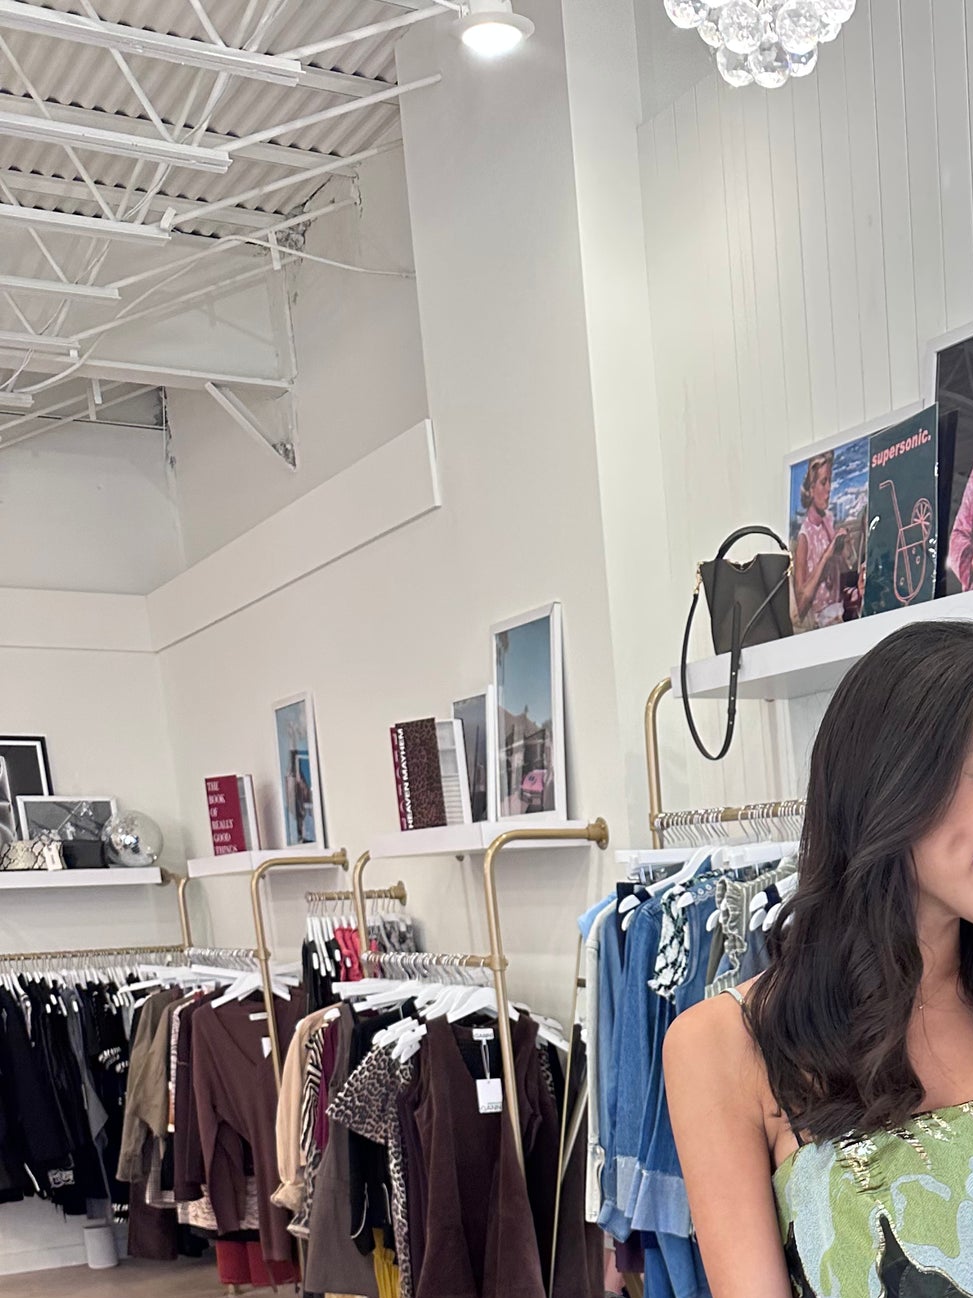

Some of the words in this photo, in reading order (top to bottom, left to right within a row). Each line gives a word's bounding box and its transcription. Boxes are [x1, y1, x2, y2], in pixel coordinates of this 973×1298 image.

[872, 428, 931, 467] supersonic.
[397, 728, 409, 780] MAYHEM
[207, 782, 219, 791] THE
[209, 794, 226, 804] BOOK
[404, 782, 414, 829] HEAVEN
[210, 807, 218, 817] OF
